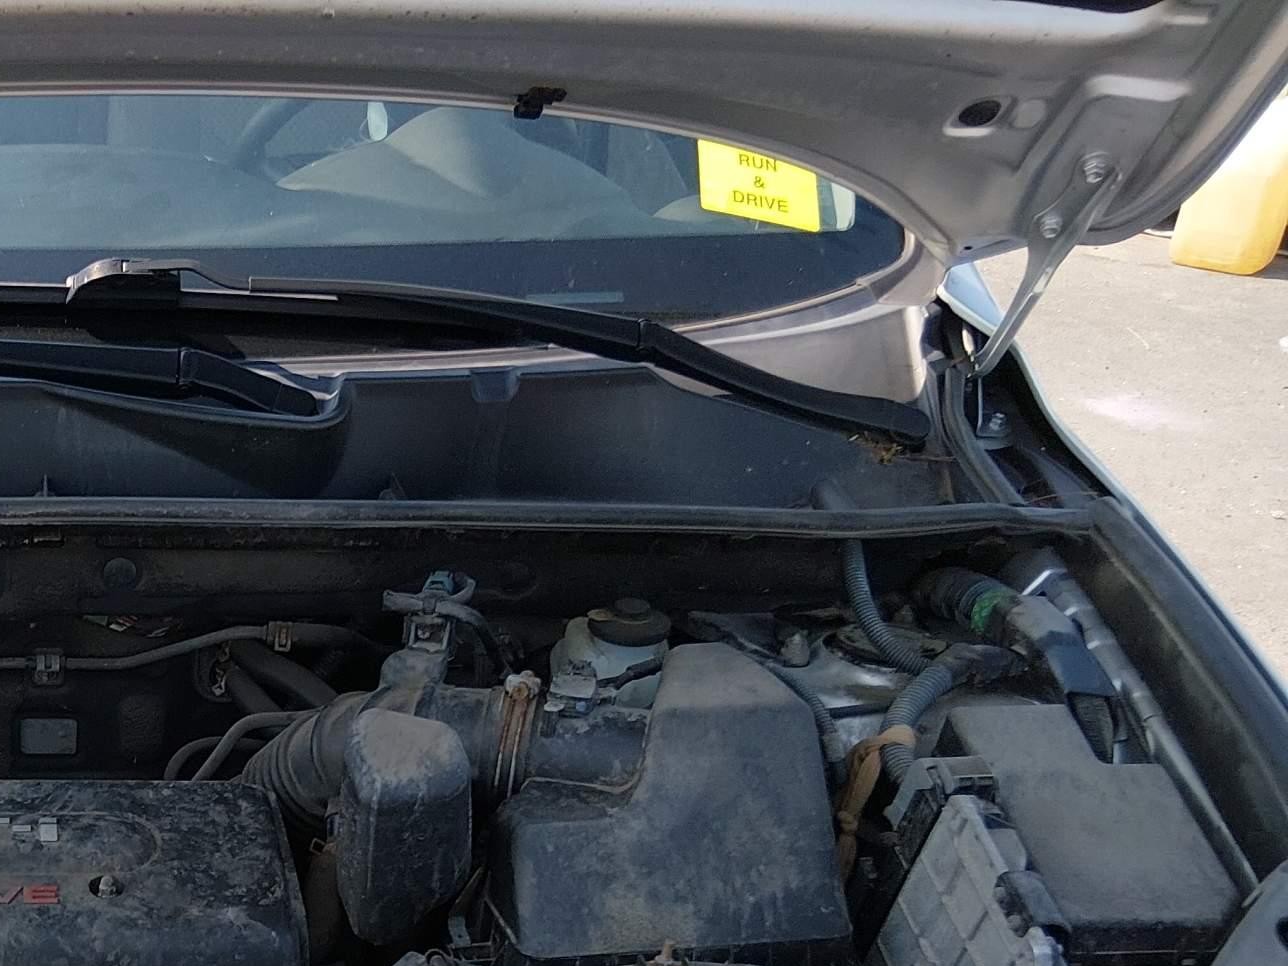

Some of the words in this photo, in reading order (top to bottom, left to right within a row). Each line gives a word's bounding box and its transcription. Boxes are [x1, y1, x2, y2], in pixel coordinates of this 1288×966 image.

[738, 153, 778, 172] RUN
[753, 175, 766, 189] &
[732, 190, 790, 213] DRIVE
